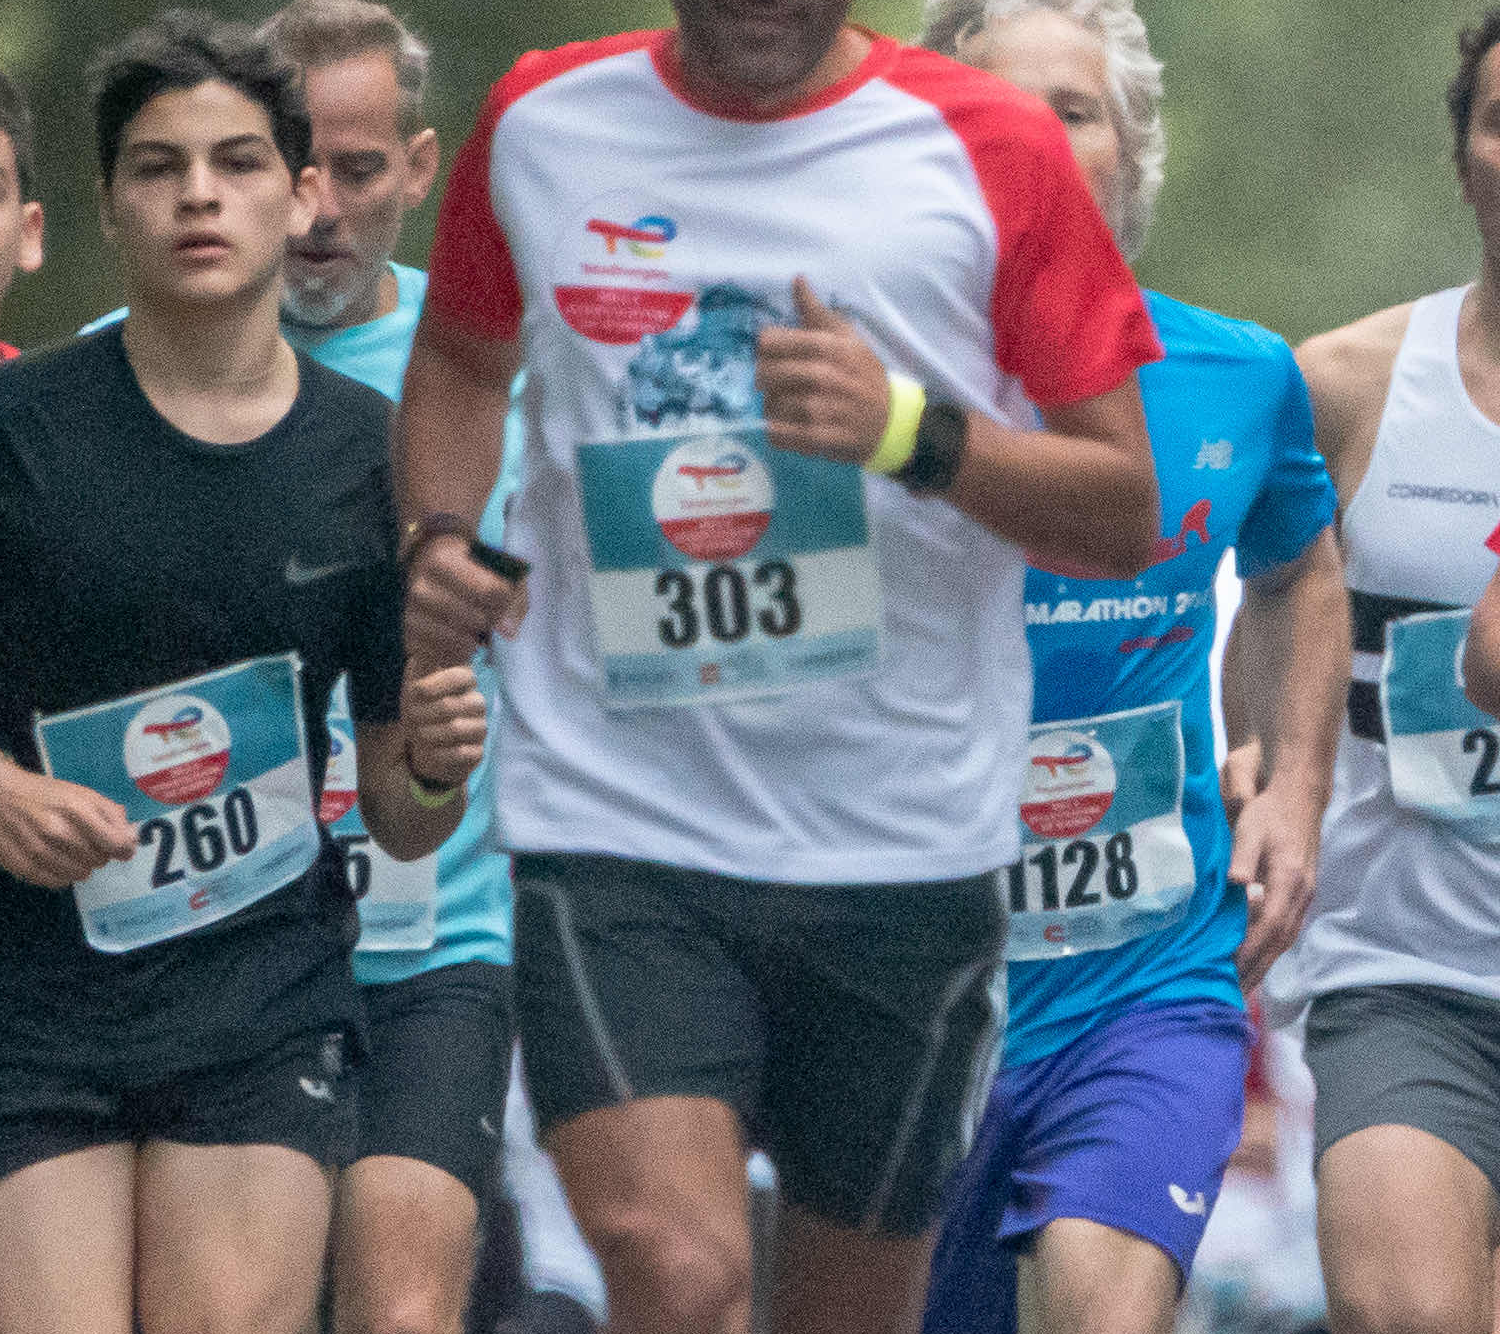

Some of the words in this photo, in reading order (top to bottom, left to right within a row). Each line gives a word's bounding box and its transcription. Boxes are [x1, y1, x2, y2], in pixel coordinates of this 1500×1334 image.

[655, 559, 802, 650] 303
[1025, 595, 1168, 625] MARATHON
[137, 787, 260, 890] 260
[1008, 830, 1139, 913] 1128
